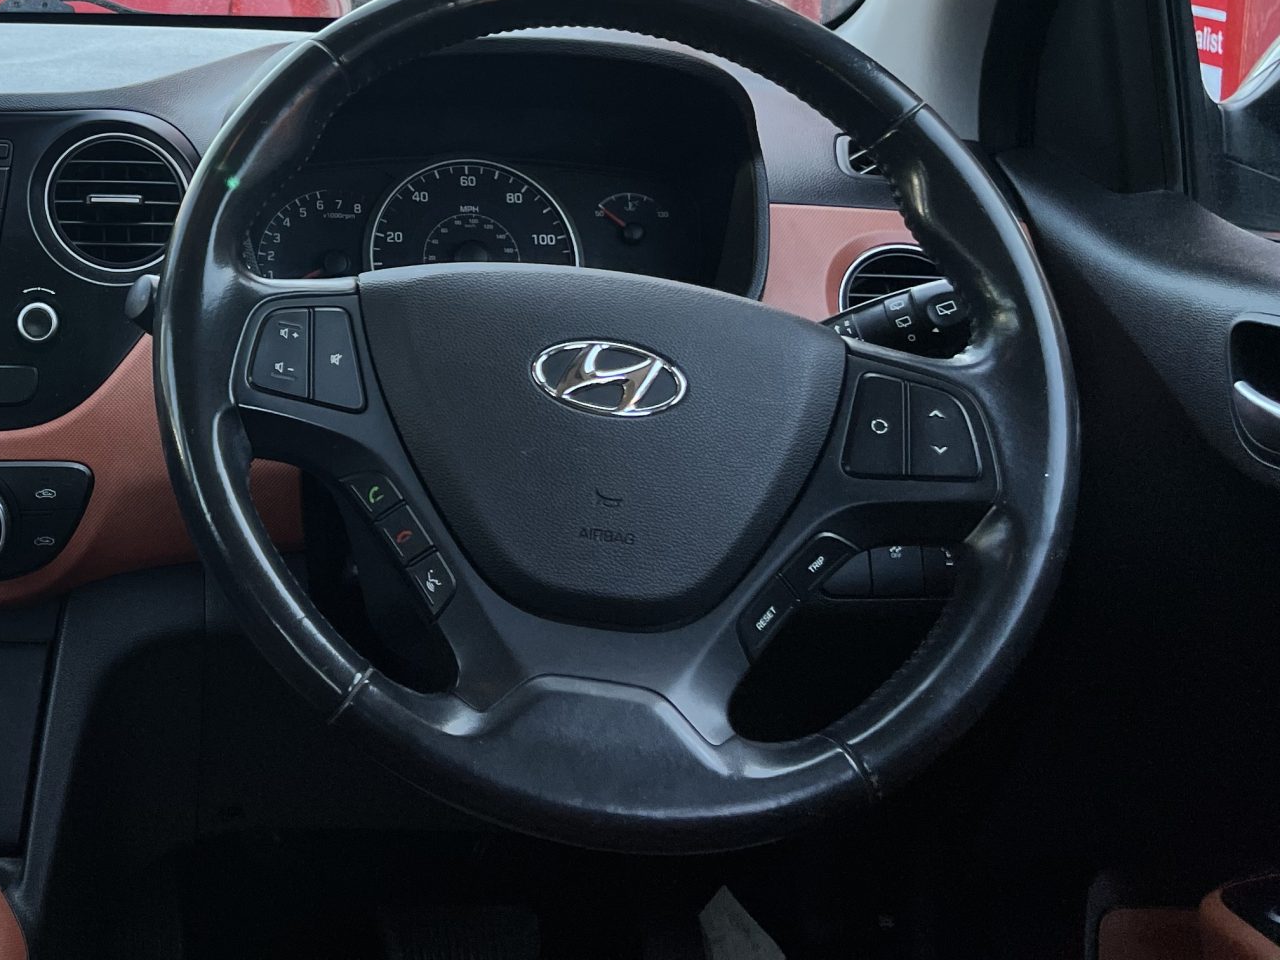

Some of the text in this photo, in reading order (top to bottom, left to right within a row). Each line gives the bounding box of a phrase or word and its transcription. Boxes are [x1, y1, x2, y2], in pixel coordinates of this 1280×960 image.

[460, 176, 476, 187] 60
[412, 192, 429, 202] 40
[506, 193, 523, 204] 80
[317, 201, 324, 210] 6
[336, 200, 342, 210] 7
[354, 204, 361, 214] 8
[300, 208, 307, 218] 5
[283, 217, 291, 227] 4
[273, 233, 280, 242] 3
[387, 231, 403, 242] 20
[532, 234, 556, 246] 100
[267, 251, 275, 261] 2
[579, 527, 636, 545] AIRBAG
[807, 555, 825, 573] TRIP
[755, 605, 777, 631] RESET
